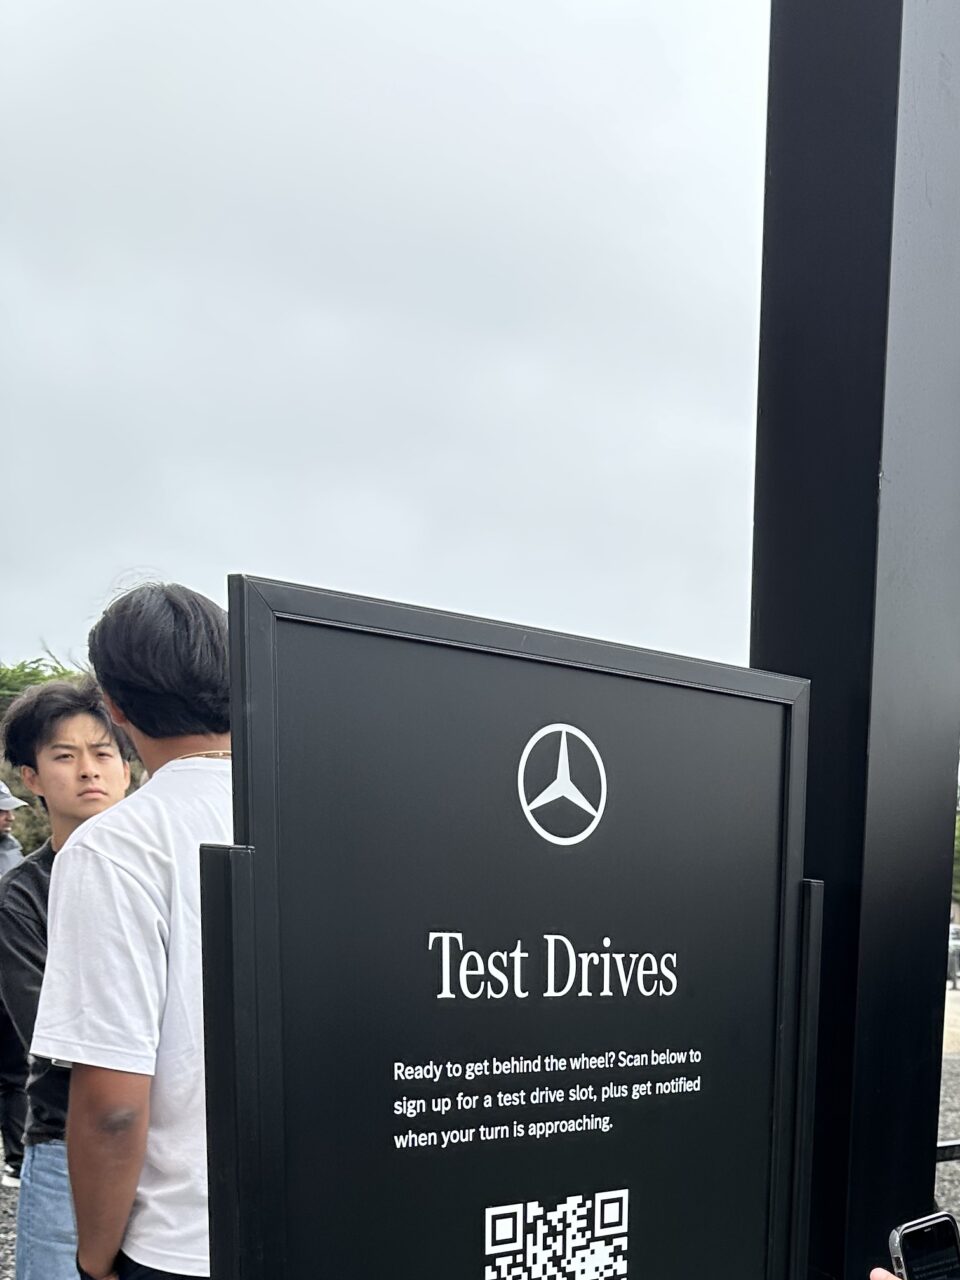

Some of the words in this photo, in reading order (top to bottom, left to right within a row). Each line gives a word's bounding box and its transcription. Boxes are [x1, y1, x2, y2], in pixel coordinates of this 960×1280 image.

[428, 931, 529, 1000] Test
[542, 934, 678, 998] Drives
[393, 1060, 444, 1083] Ready
[445, 1061, 463, 1078] to
[464, 1059, 490, 1081] get
[492, 1054, 542, 1076] behind
[543, 1054, 567, 1072] the
[569, 1050, 616, 1070] wheel?
[617, 1050, 649, 1068] Scan
[650, 1048, 688, 1066] below
[688, 1048, 702, 1064] to
[393, 1095, 426, 1118] sign
[431, 1097, 452, 1115] up
[455, 1091, 480, 1110] for
[483, 1094, 493, 1108] a
[496, 1089, 527, 1107] test
[529, 1085, 565, 1105] drive
[568, 1083, 598, 1103] slot,
[601, 1081, 629, 1103] plus
[631, 1080, 653, 1100] get
[655, 1075, 701, 1095] notified
[393, 1129, 438, 1149] when
[440, 1128, 476, 1149] your
[478, 1124, 510, 1141] turn
[513, 1120, 525, 1138] is
[527, 1113, 614, 1139] approaching.
